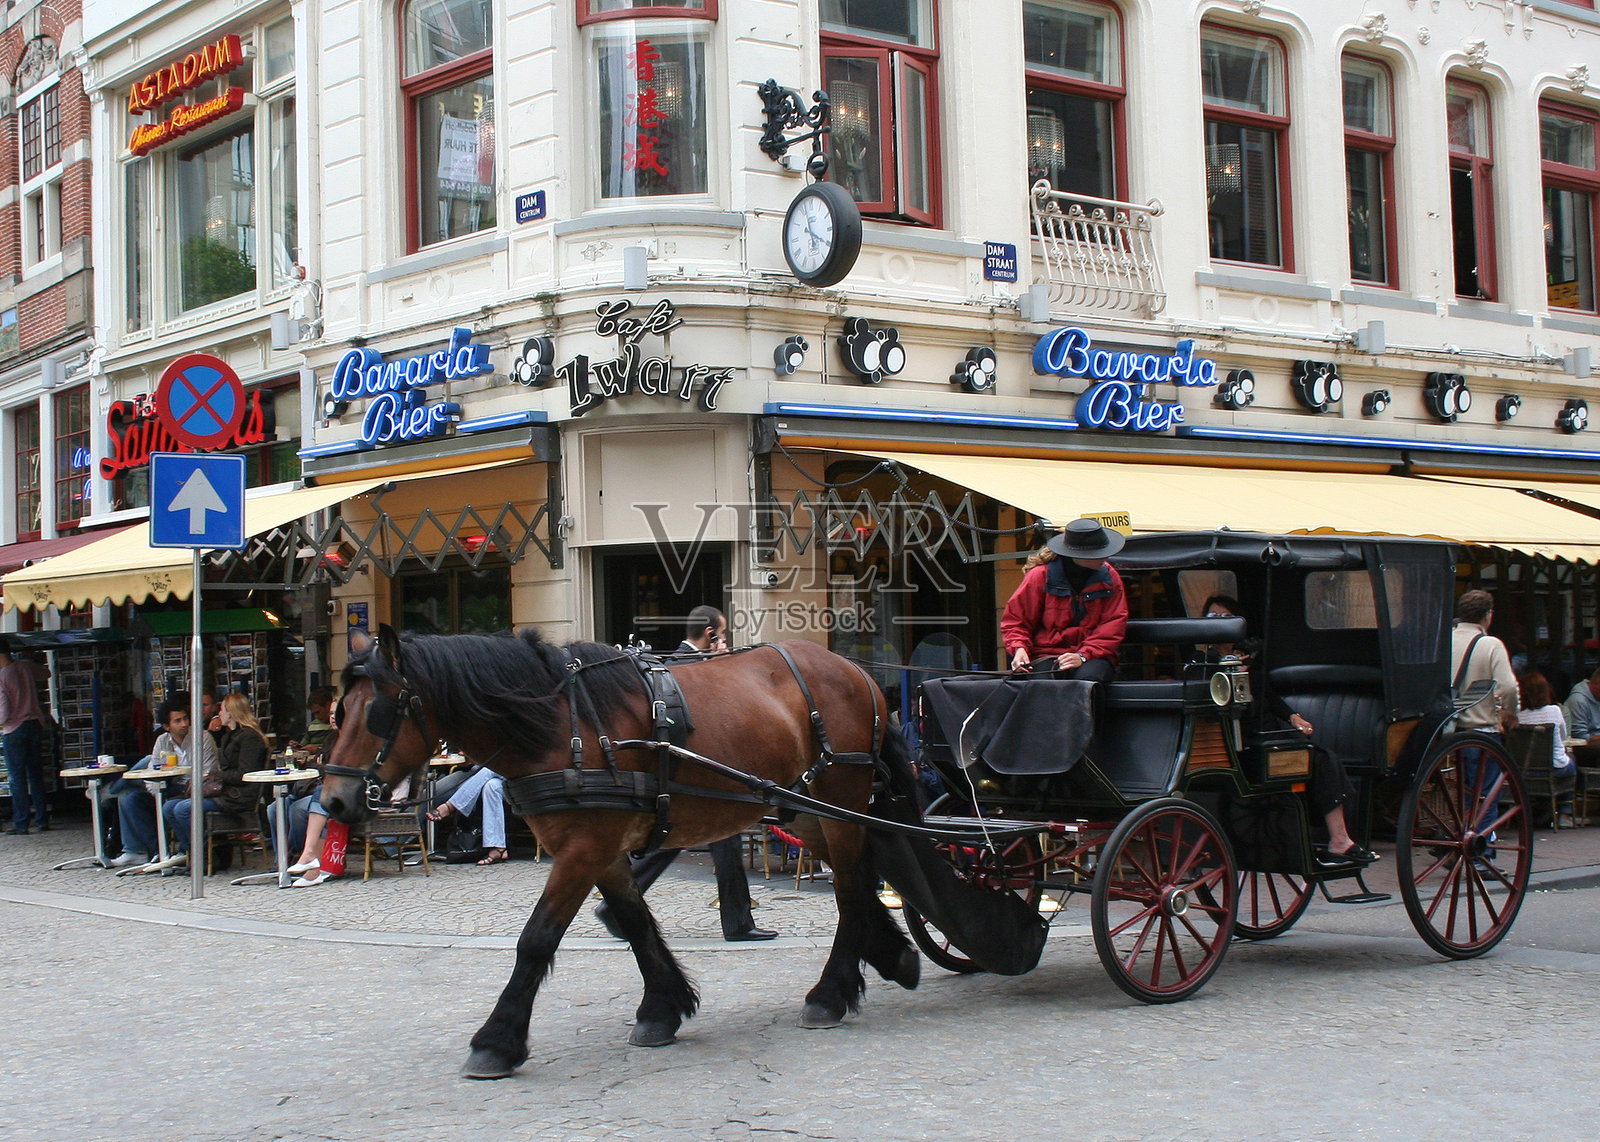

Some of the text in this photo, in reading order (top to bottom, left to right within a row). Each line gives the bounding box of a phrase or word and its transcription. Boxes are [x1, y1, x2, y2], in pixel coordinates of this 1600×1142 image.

[128, 35, 232, 113] ASIADAM
[622, 39, 669, 177] 香港城
[519, 207, 541, 219] CENTRUM
[521, 195, 537, 209] DAM
[987, 244, 1005, 256] DAM
[987, 257, 1015, 270] STRAAT
[991, 270, 1015, 279] CENTRUM
[330, 328, 486, 400] Bavaria
[554, 342, 736, 418] Zwart
[1042, 326, 1221, 388] Bavaria
[361, 391, 450, 443] Bier
[1083, 380, 1185, 431] Bier
[1102, 515, 1130, 527] TOURS
